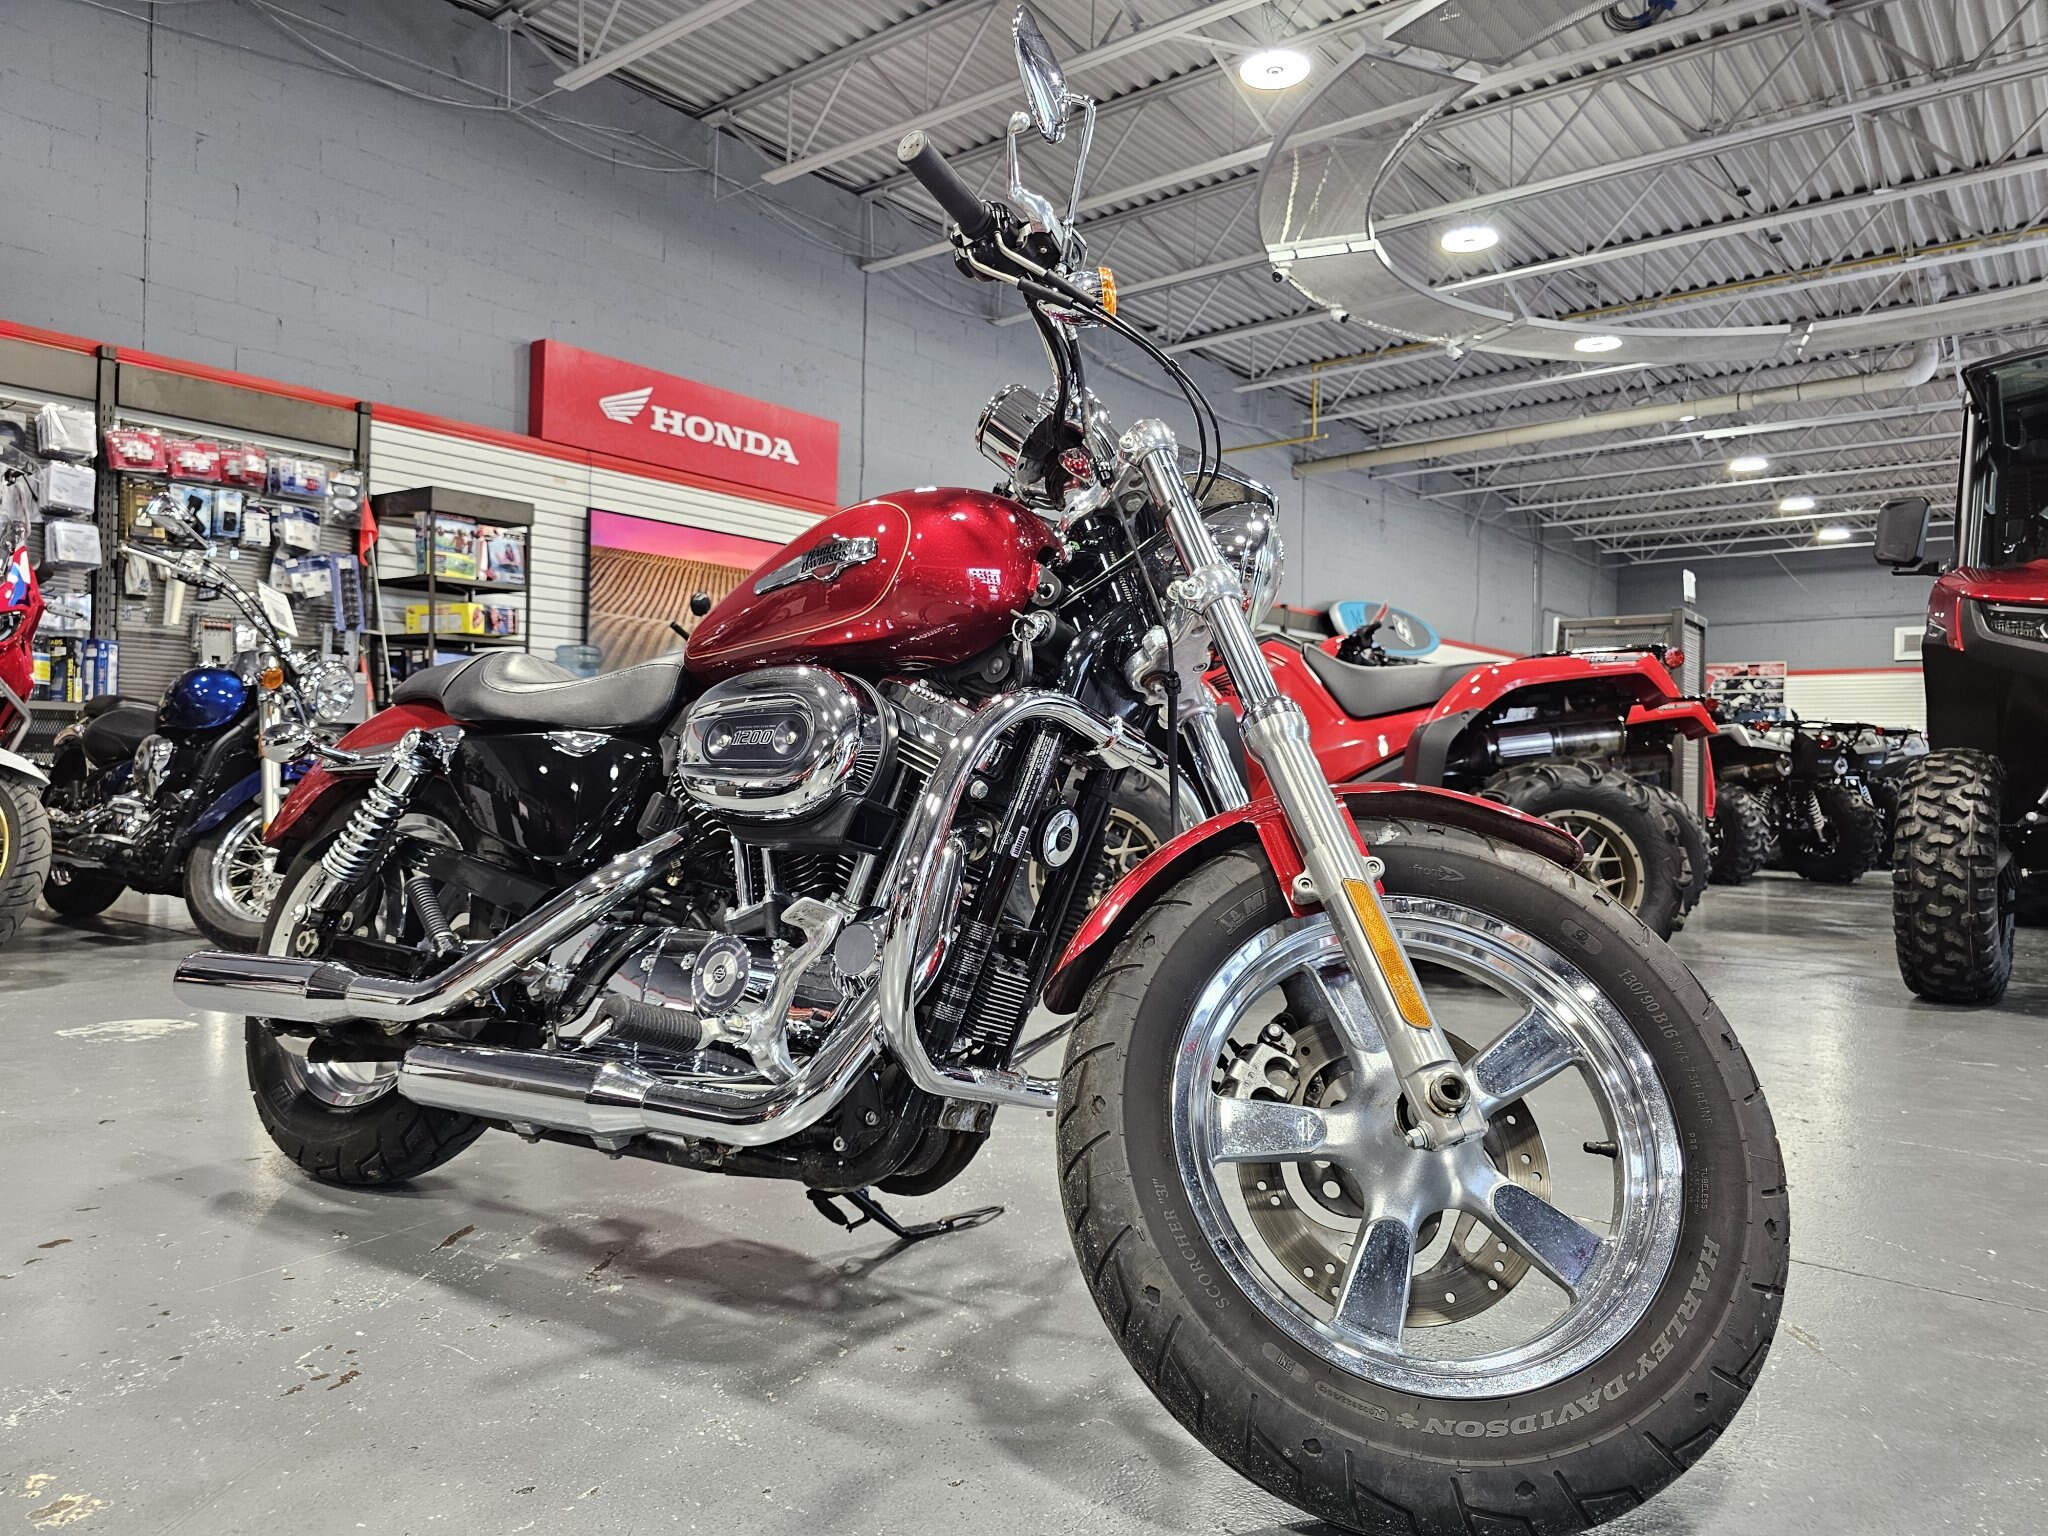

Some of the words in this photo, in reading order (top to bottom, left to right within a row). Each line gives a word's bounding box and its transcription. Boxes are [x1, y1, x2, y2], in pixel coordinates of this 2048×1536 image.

[650, 405, 799, 465] HONDA
[801, 550, 847, 573] DAVIDSON
[806, 542, 847, 561] HARLEY
[731, 729, 775, 746] 1200
[1700, 1167, 1709, 1210] TUBELESS
[1163, 1209, 1230, 1309] SCORCHER
[1422, 1235, 1721, 1438] HARLEY-DAVIDSON
